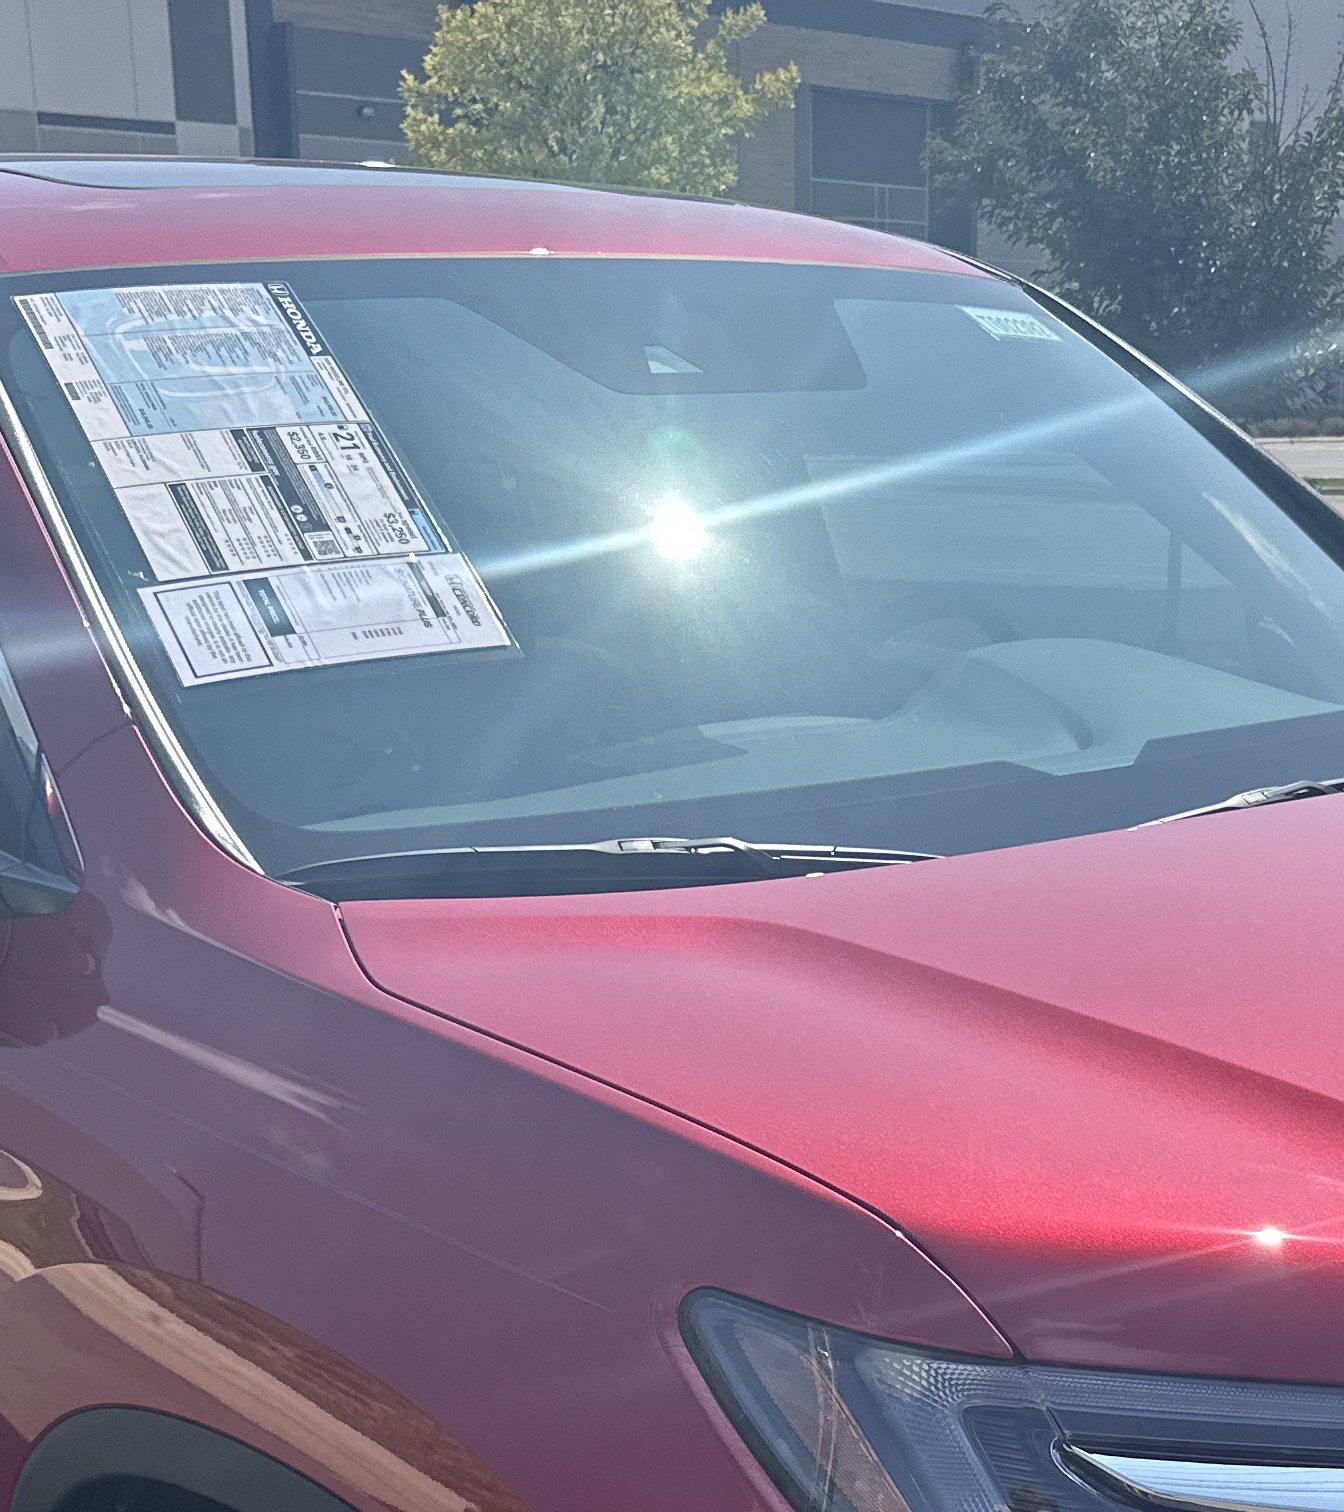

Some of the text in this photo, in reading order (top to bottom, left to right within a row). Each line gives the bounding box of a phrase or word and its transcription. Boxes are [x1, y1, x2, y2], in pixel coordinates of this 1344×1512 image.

[276, 295, 325, 354] HONDA
[284, 430, 312, 460] $2,350
[330, 431, 361, 451] 21
[380, 511, 412, 545] $3,250
